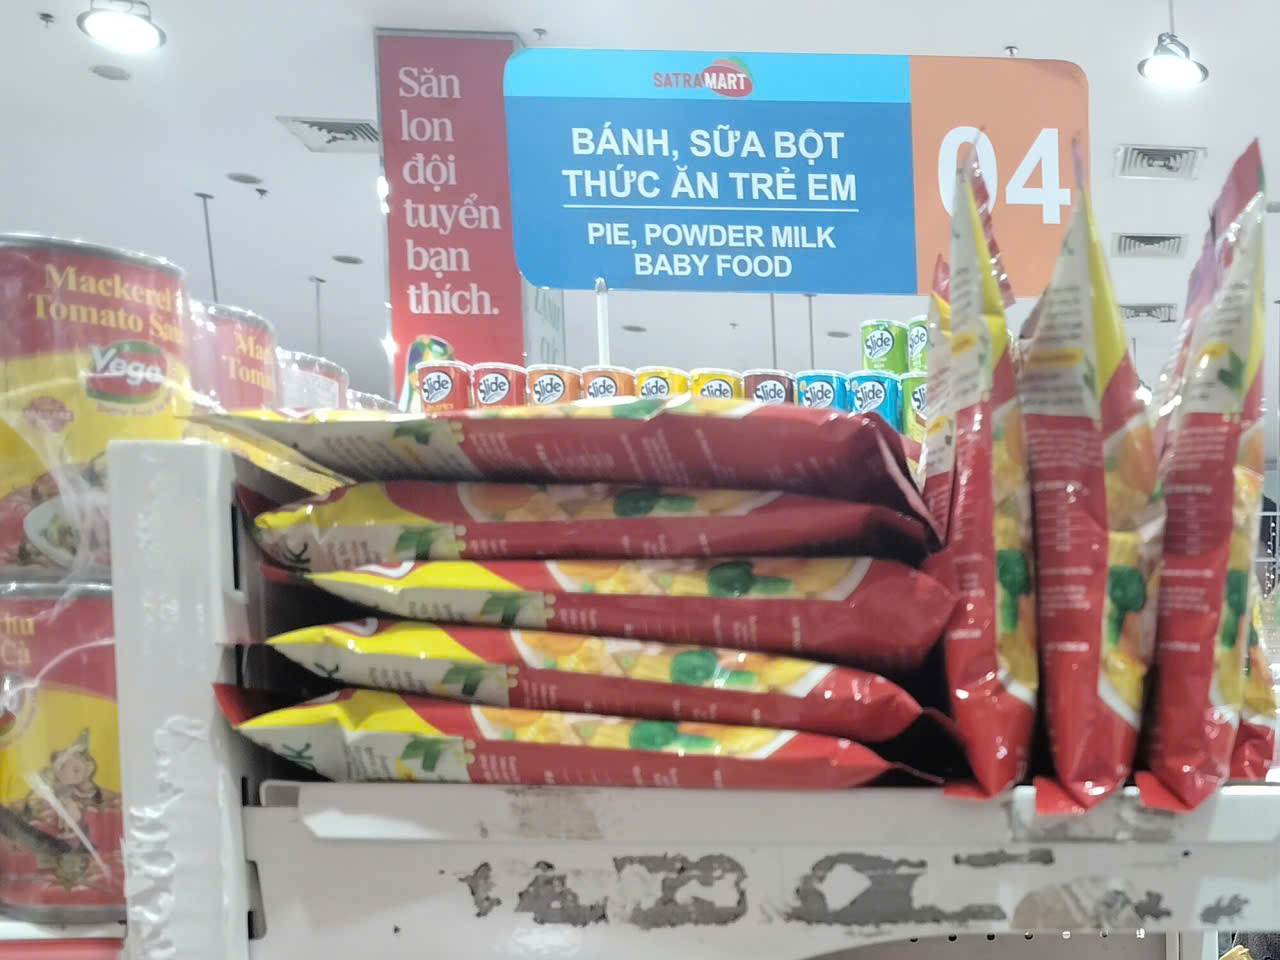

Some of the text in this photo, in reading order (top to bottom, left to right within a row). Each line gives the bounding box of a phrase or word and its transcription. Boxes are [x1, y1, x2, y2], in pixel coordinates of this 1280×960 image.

[398, 67, 461, 98] Săn
[400, 109, 455, 142] lon
[571, 122, 845, 165] BÁNH, SỮA BỘT
[402, 153, 457, 192] đội
[561, 164, 857, 201] THỨC ĂN TRẺ EM
[937, 125, 1071, 225] 04
[403, 193, 502, 235] tuyển
[587, 223, 837, 249] PIE, POWDER MILK
[406, 239, 471, 278] bạn
[634, 253, 793, 278] BABY FOOD
[29, 293, 143, 333] Tomato
[406, 282, 500, 315] thích.
